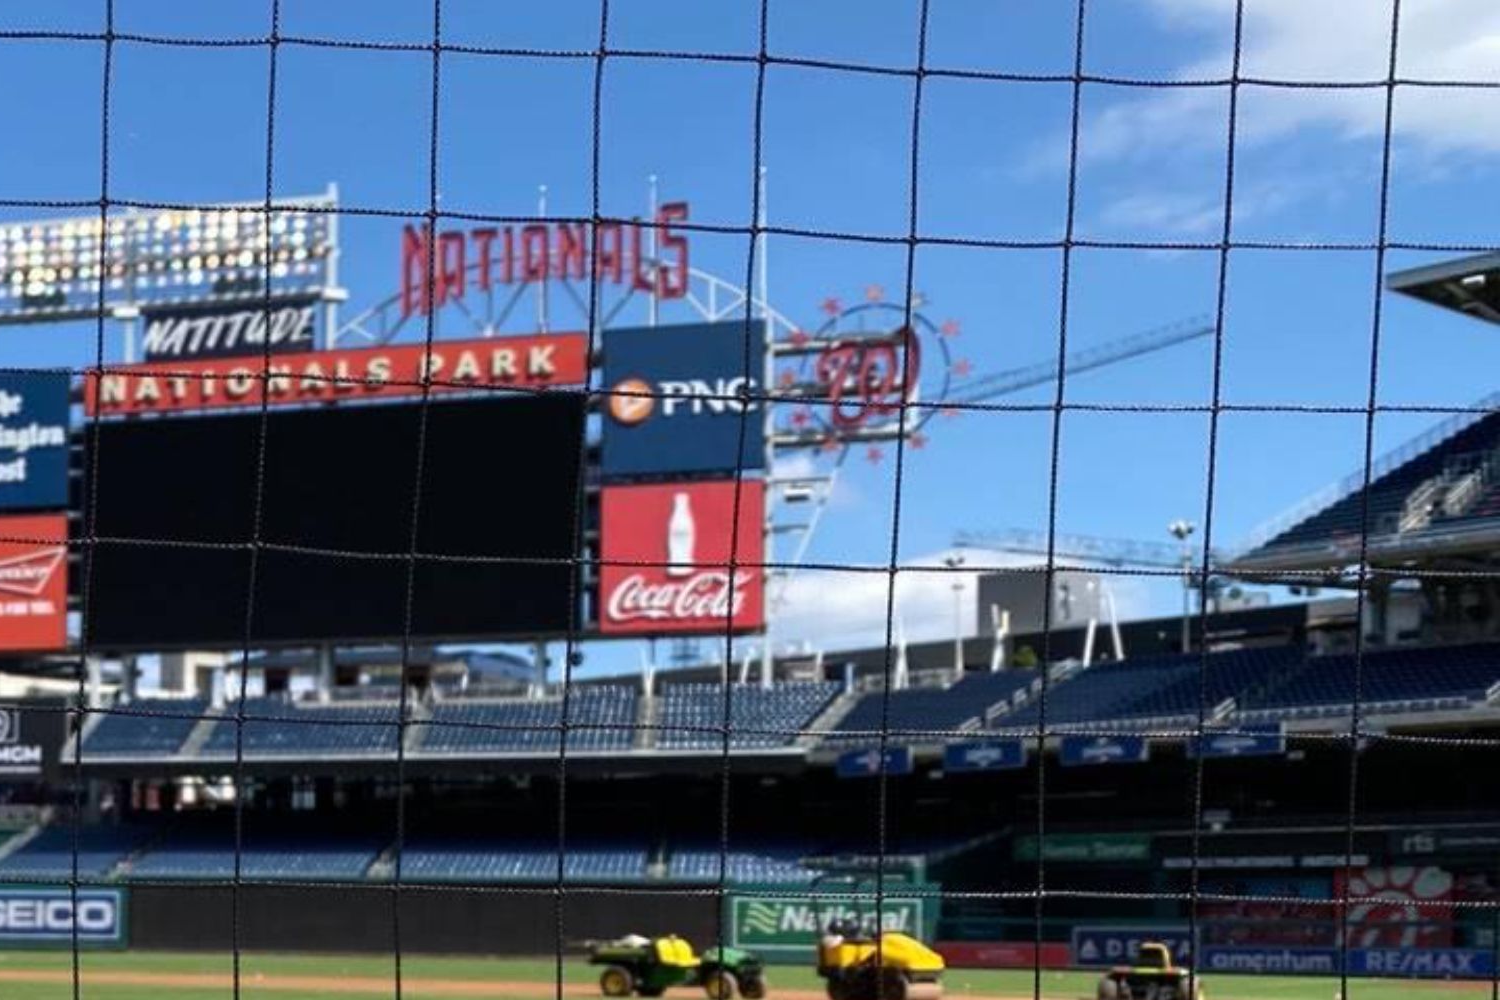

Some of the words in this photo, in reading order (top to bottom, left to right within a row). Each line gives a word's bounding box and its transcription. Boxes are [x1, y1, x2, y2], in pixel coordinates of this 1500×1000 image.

[403, 202, 687, 316] NATIONALS
[143, 306, 314, 355] NATITUDE
[100, 356, 392, 402] NATIONALS
[419, 345, 558, 384] PARK
[658, 377, 758, 415] PNC
[1105, 938, 1193, 959] DETA
[1365, 952, 1475, 973] RE/MAX
